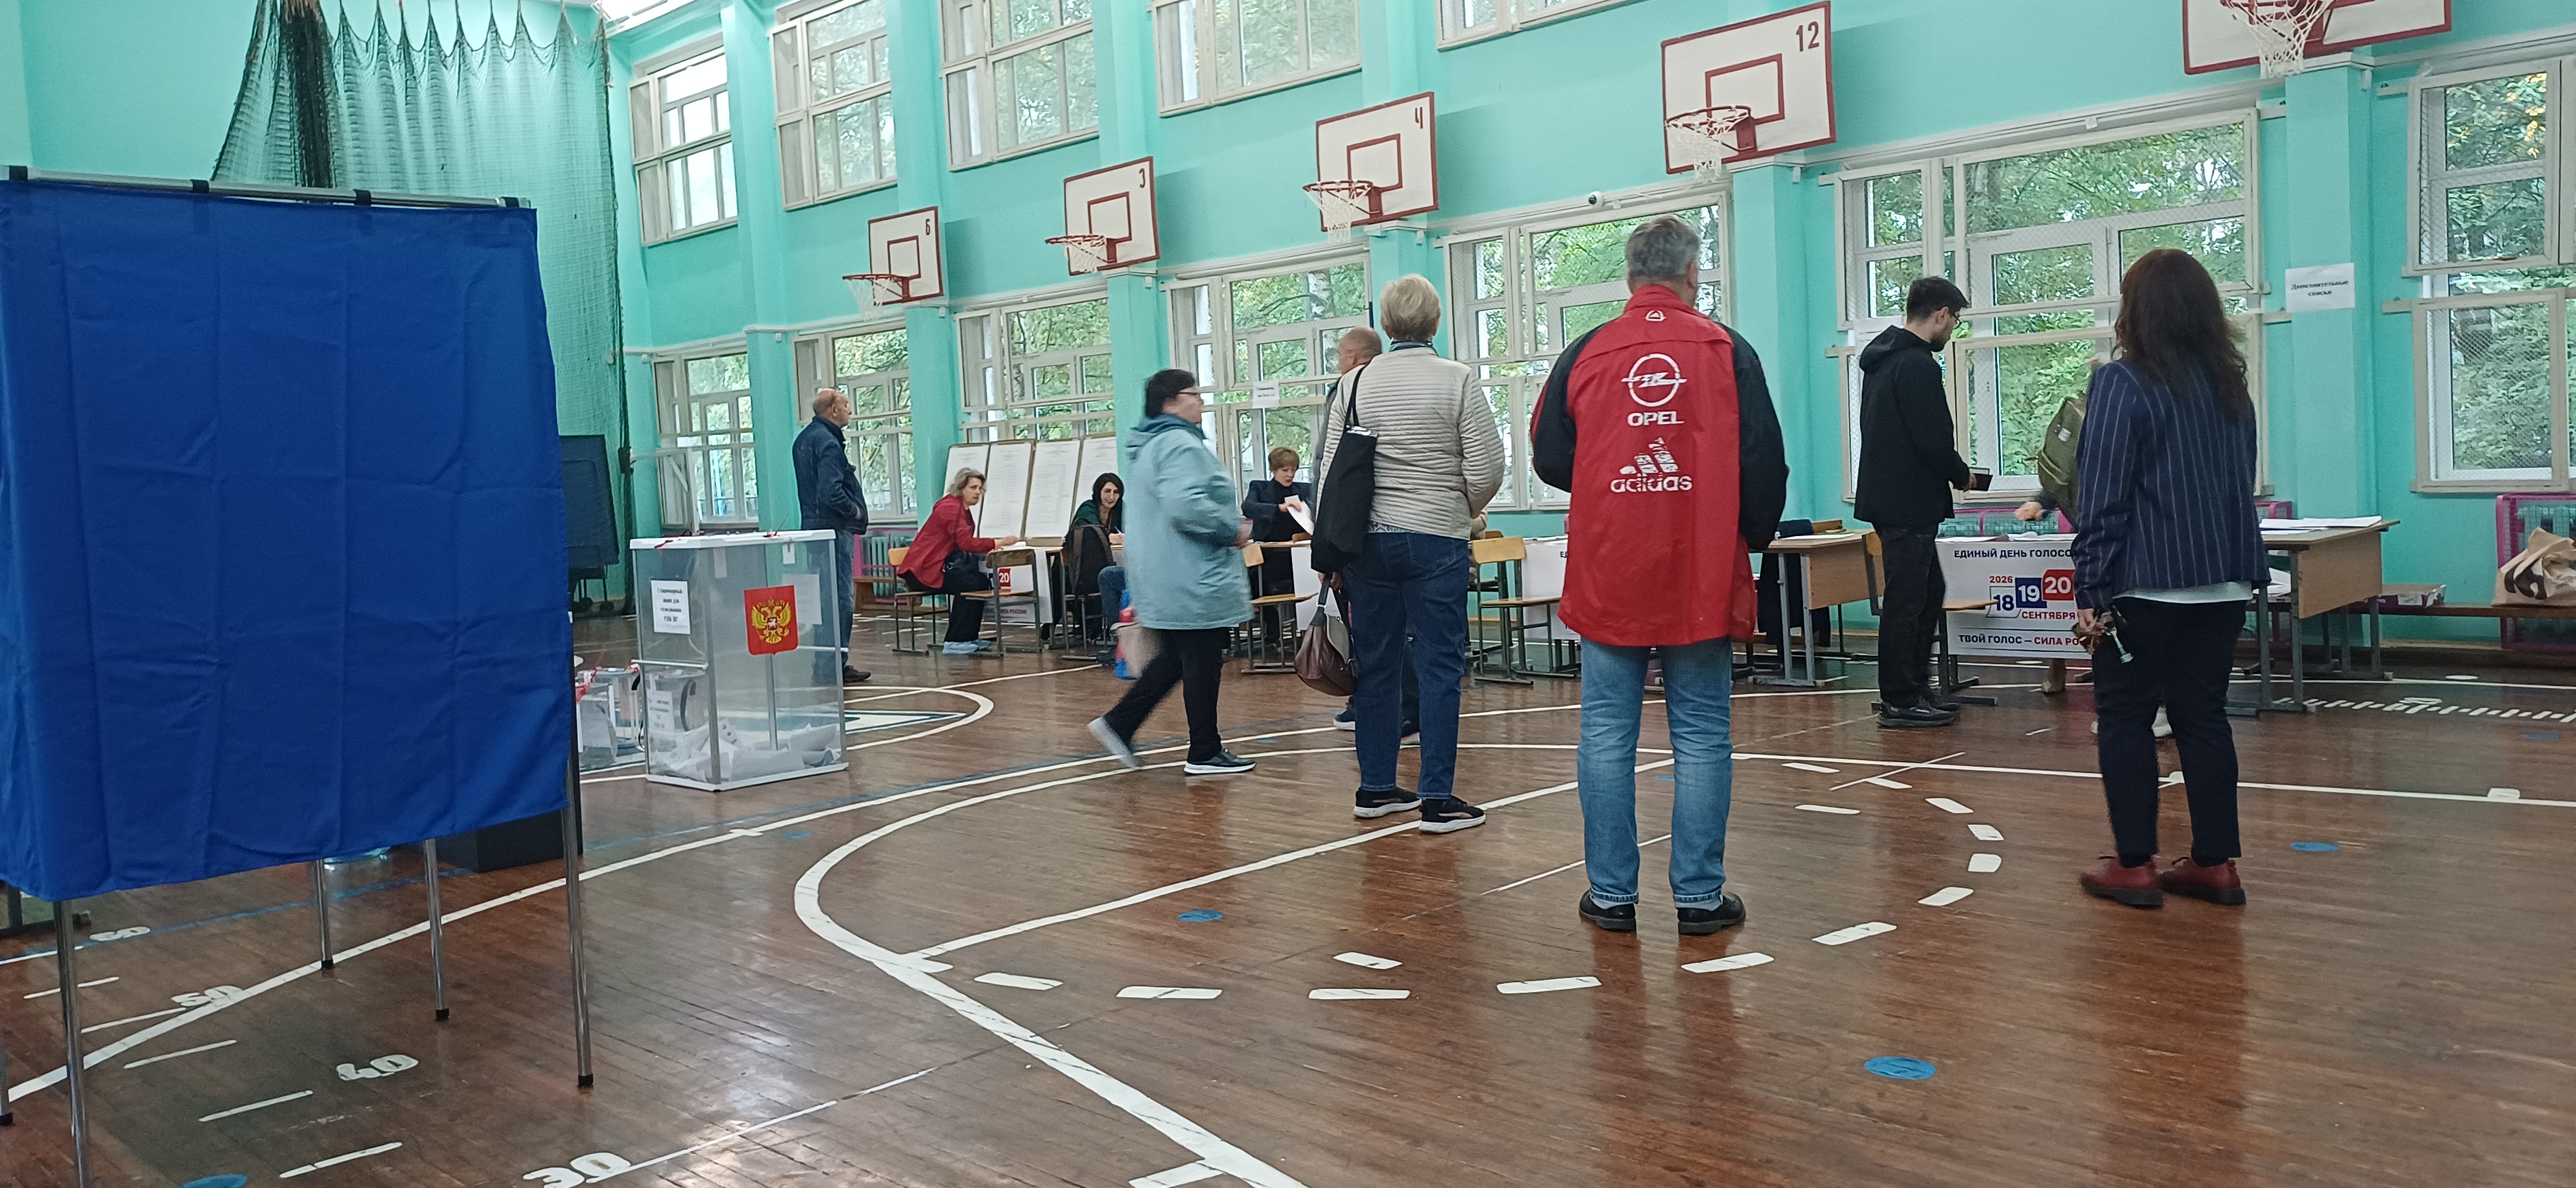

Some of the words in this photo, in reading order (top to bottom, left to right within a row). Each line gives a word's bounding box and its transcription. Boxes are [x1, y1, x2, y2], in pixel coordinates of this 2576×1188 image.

[1795, 21, 1820, 52] 12
[1414, 106, 1423, 129] 4
[925, 218, 931, 236] 6
[1627, 410, 1685, 426] OPEL
[1610, 472, 1693, 493] adidas
[1954, 548, 1997, 559] ЕДИНЫЙ
[2000, 550, 2027, 559] ДЕНЬ
[998, 572, 1010, 583] 20
[1989, 575, 2013, 584] 2026
[1993, 594, 2015, 611] 18
[2018, 584, 2040, 603] 19
[2044, 576, 2072, 594] 20
[2022, 611, 2076, 620] СЕНТЯБРЯ
[1958, 633, 1985, 643] ТВОЙ
[1988, 635, 2022, 644] ГОЛОС
[2034, 637, 2063, 645] СИЛА
[336, 1054, 419, 1081] 40
[522, 1152, 631, 1188] 30
